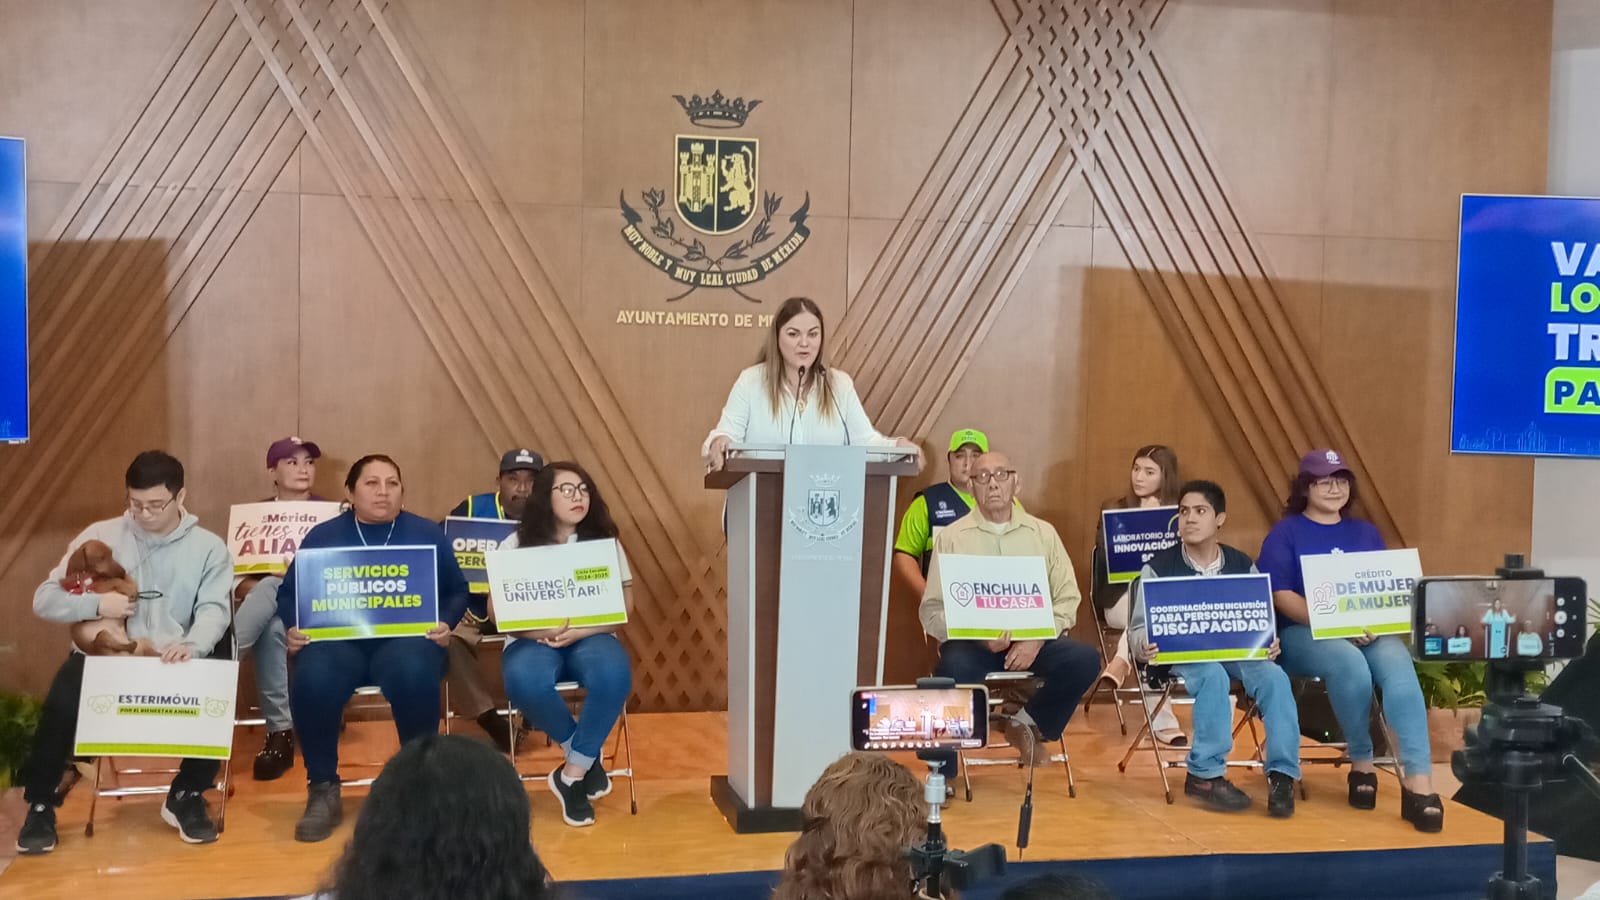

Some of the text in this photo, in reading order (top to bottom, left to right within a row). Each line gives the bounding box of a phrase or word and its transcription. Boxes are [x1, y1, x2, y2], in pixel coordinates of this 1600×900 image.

[623, 224, 805, 286] MUY NOBLE Y MUY LEAL CIUDAD DE MÉRIDA
[616, 310, 729, 327] AYUNTAMIENTO
[734, 313, 753, 327] DE
[234, 521, 292, 541] tienes
[1112, 531, 1175, 543] LABORATORIO de
[323, 564, 409, 579] SERVICIOS
[1354, 569, 1392, 579] CRÉDITO
[326, 578, 407, 595] PÚBLICOS
[974, 582, 1041, 595] ENCHULA
[1335, 581, 1358, 595] DE
[312, 594, 422, 612] MUNICIPALES
[980, 596, 1038, 608] TU CASA
[1150, 601, 1214, 614] COORDINACIÓN
[1224, 600, 1267, 610] INCLUSIÓN
[1346, 597, 1357, 610] A
[1151, 609, 1268, 623] PARA PERSONAS CON
[1152, 619, 1269, 636] DISCAPACIDAD
[118, 692, 201, 706] ESTERIMÓVIL
